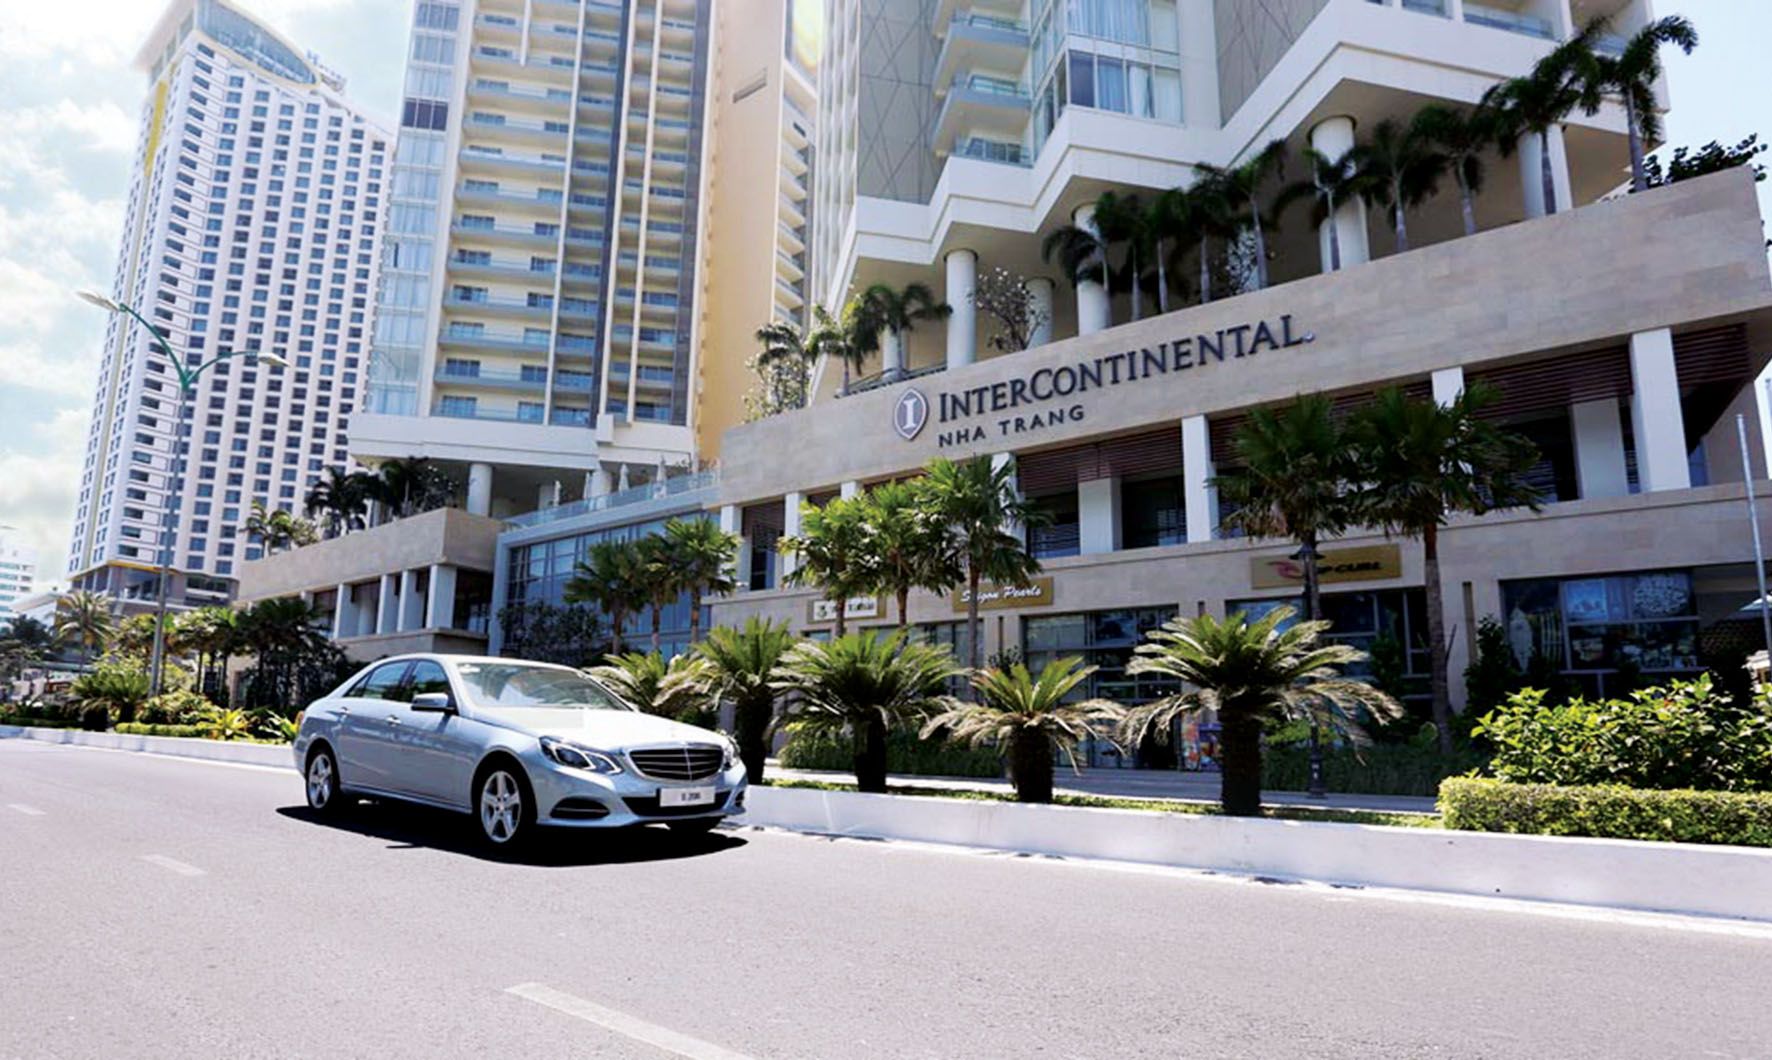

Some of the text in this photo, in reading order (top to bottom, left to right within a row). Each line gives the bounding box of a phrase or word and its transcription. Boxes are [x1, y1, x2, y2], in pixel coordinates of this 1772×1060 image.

[939, 314, 1304, 423] INTERCONTINENTAL
[938, 404, 1085, 448] NHA TRANG
